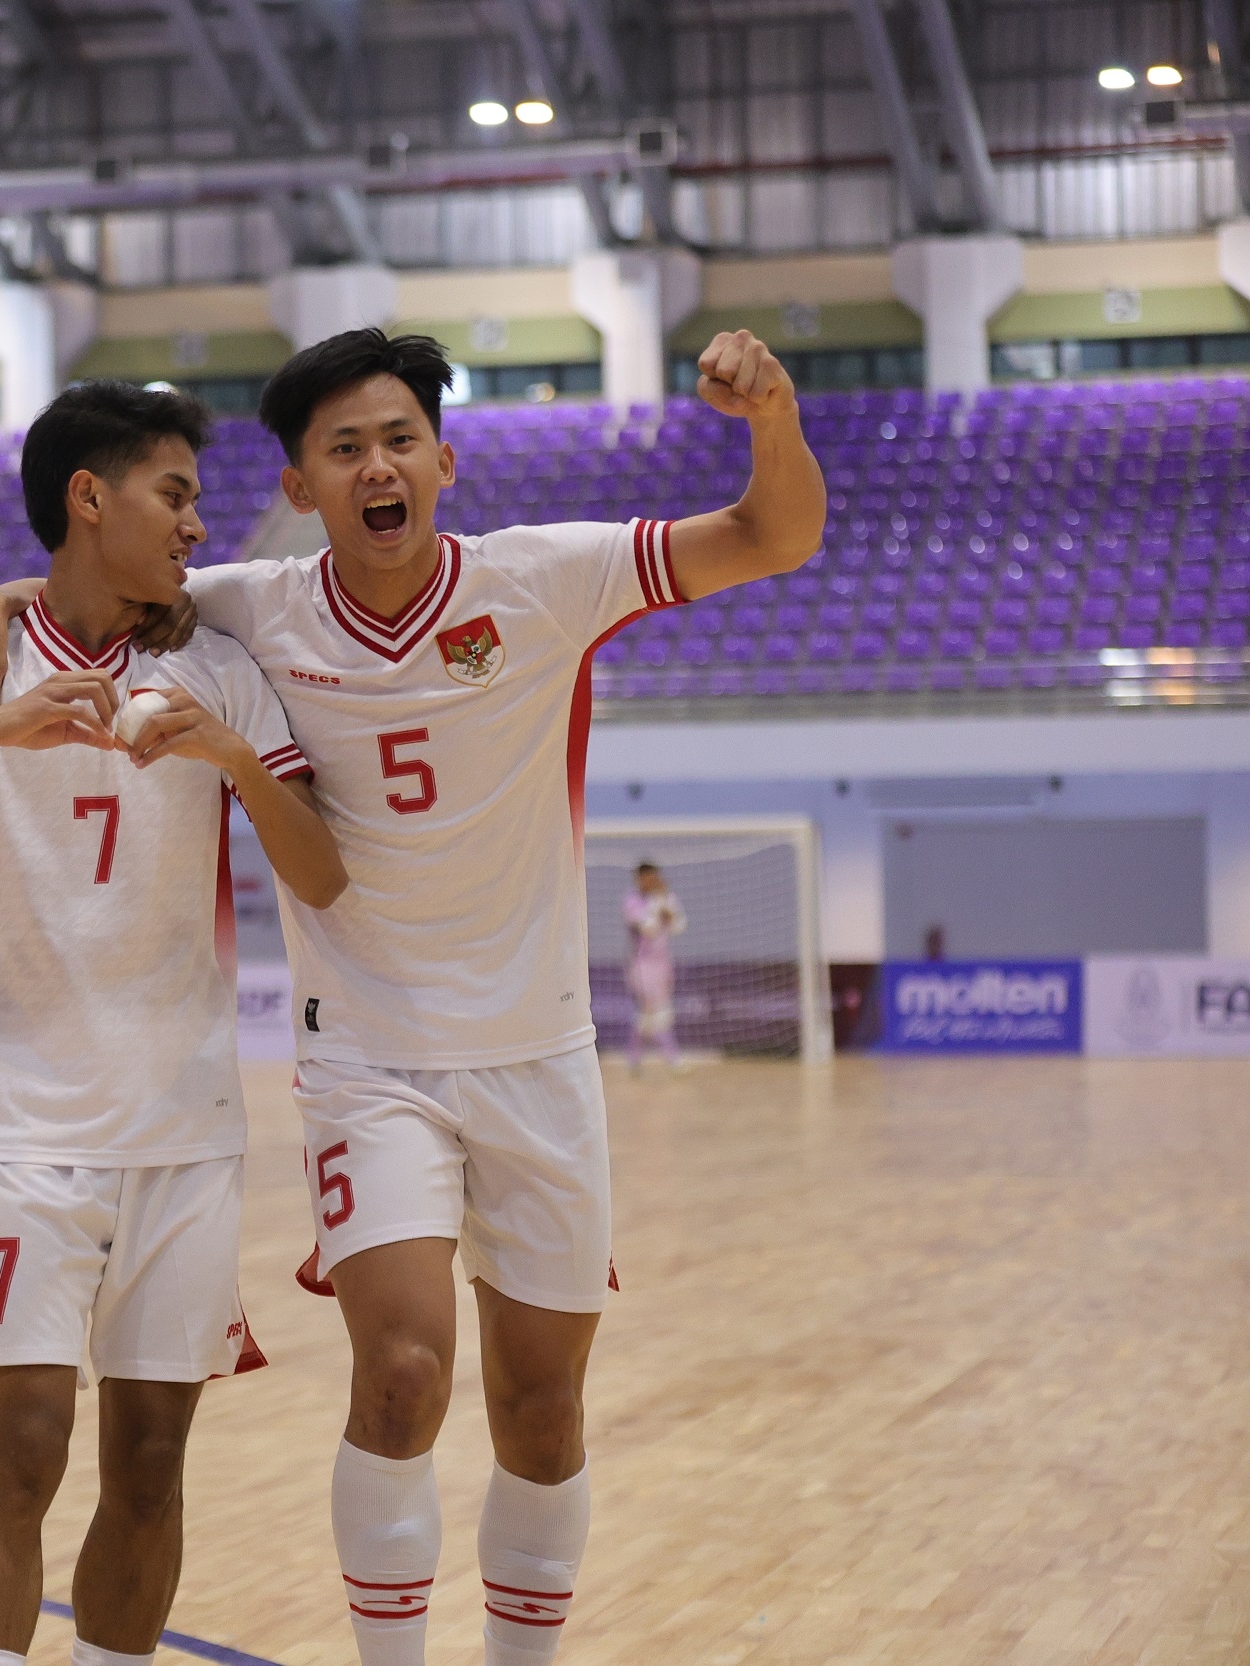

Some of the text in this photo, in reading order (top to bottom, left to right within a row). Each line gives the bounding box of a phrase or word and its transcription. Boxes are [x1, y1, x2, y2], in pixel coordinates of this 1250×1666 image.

[289, 669, 341, 685] SPECS
[376, 727, 438, 815] 5
[73, 795, 120, 885] 7
[316, 1140, 355, 1231] 5
